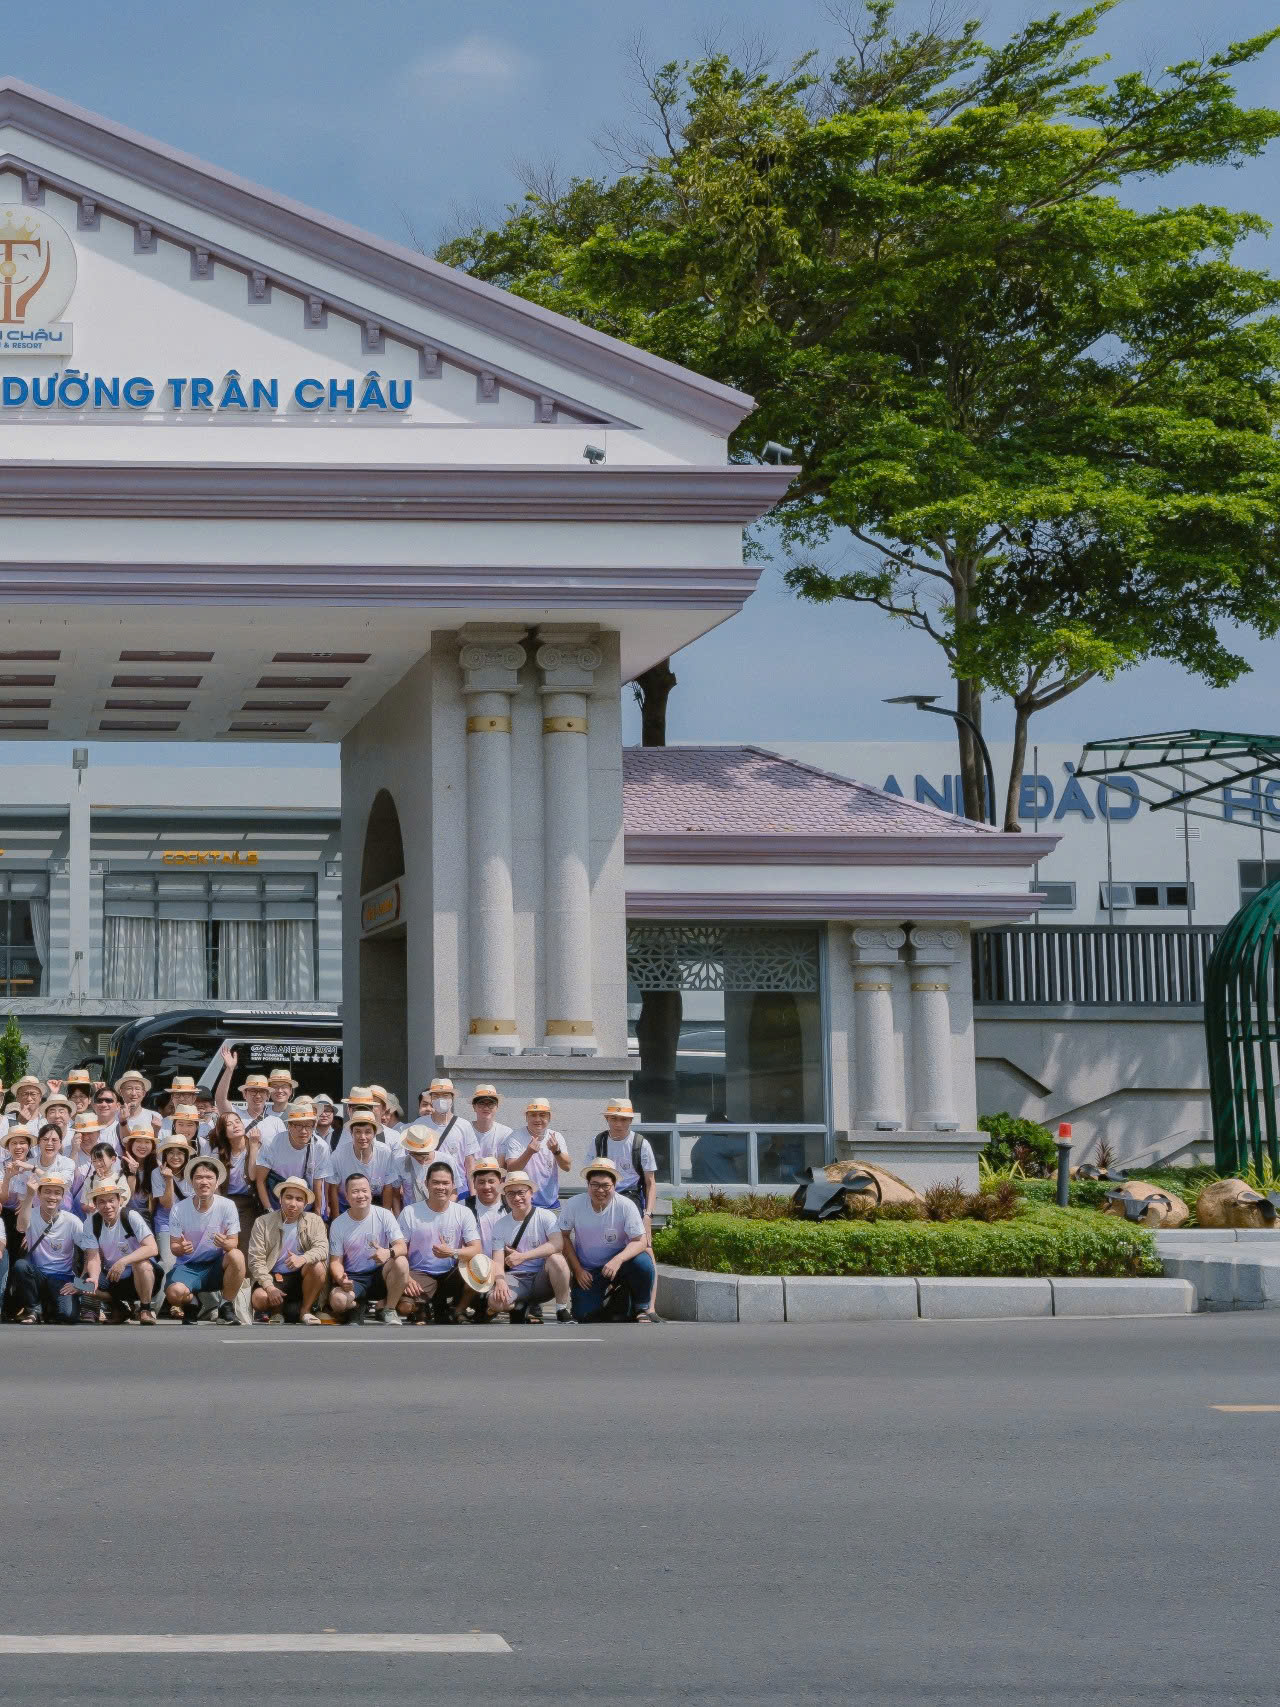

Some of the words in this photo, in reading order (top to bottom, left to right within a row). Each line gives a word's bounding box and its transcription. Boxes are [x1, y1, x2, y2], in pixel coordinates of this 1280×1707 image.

[7, 328, 62, 341] CHÂU
[2, 369, 155, 408] DƯỠNG
[167, 369, 279, 409] TRÂN
[294, 370, 412, 411] CHÂU
[162, 850, 259, 866] COCKTAILS
